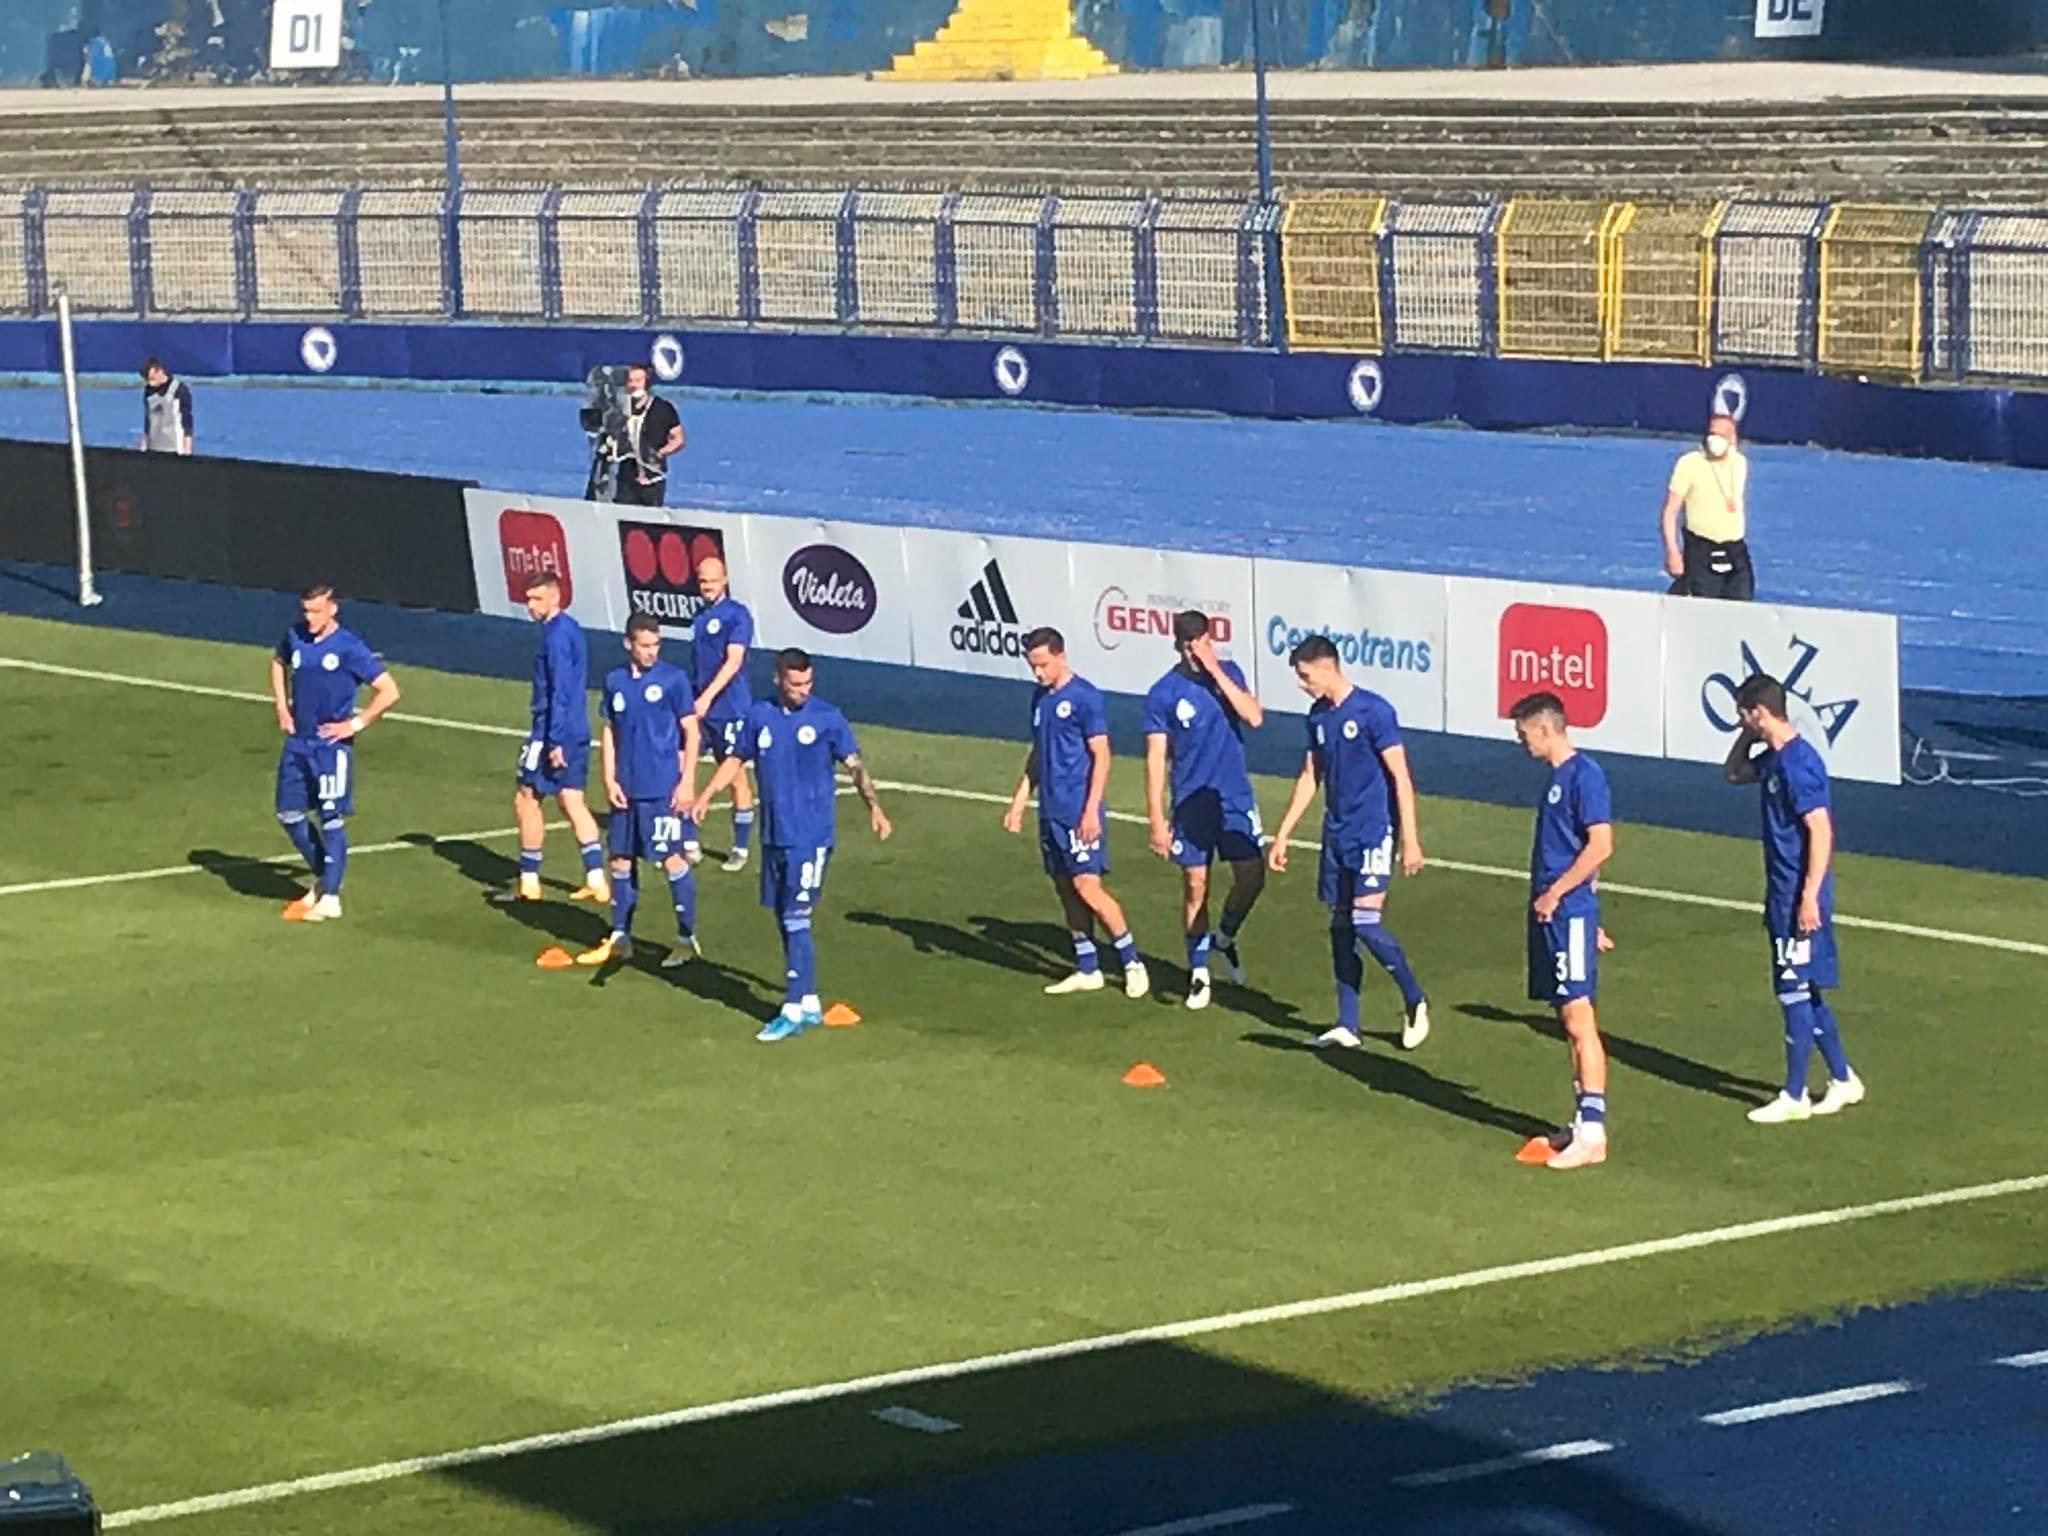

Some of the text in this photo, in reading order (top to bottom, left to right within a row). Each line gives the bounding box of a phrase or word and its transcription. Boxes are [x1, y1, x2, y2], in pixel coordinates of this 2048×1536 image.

[508, 541, 562, 577] m:tel
[792, 565, 867, 609] Violeta
[1508, 643, 1594, 690] m:tel
[318, 774, 336, 799] 11
[1555, 951, 1568, 981] 3
[1775, 937, 1797, 966] 14
